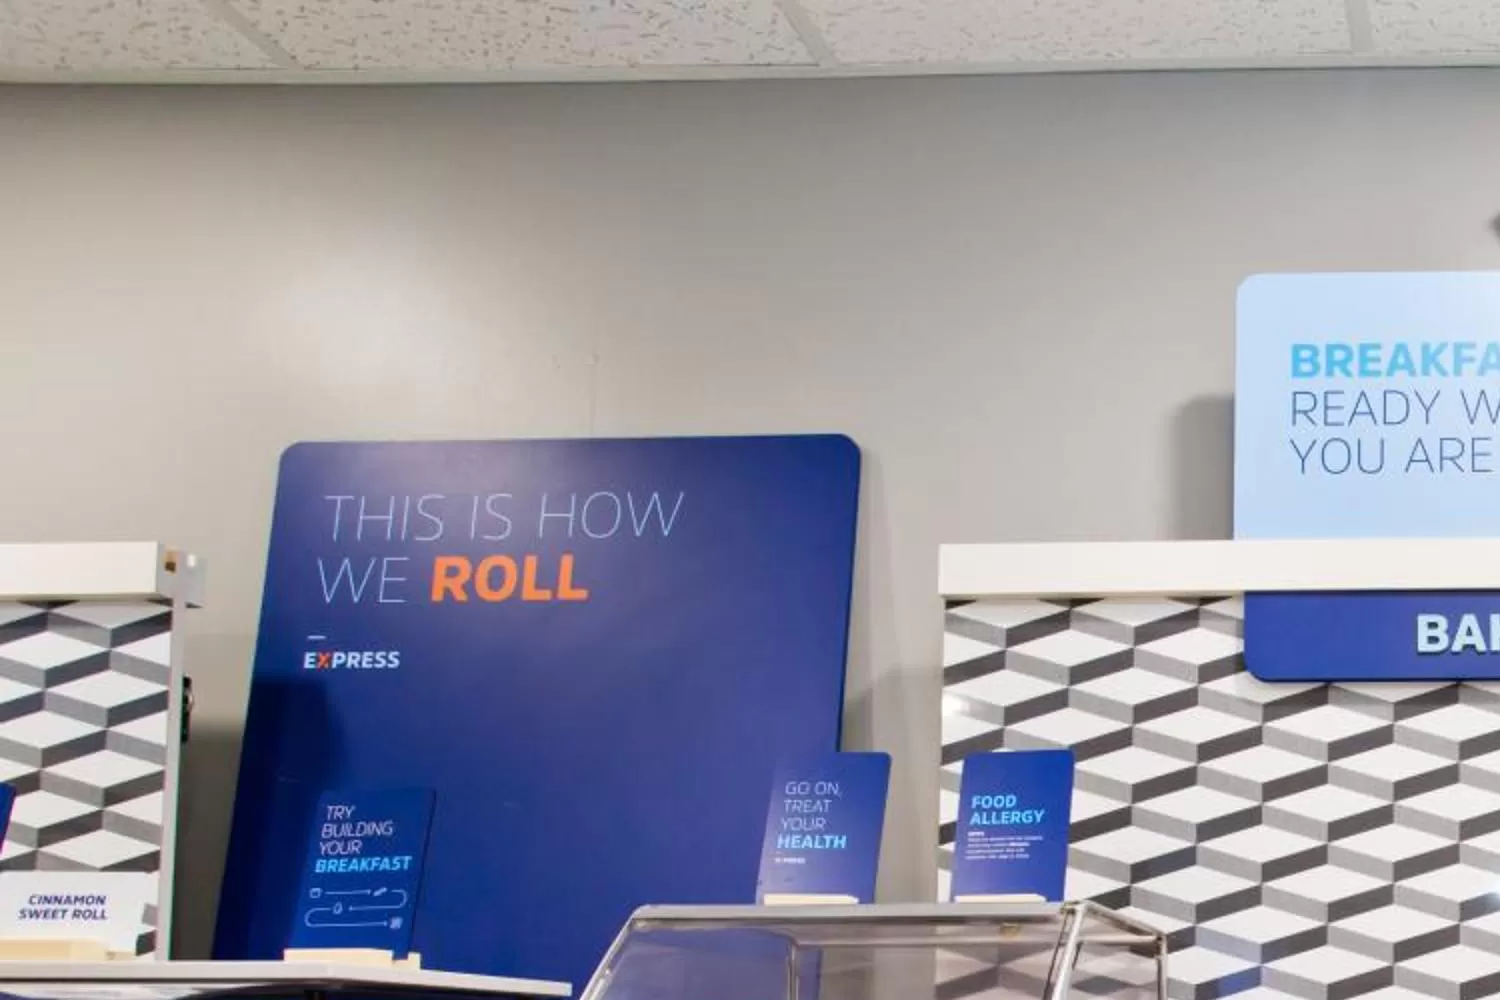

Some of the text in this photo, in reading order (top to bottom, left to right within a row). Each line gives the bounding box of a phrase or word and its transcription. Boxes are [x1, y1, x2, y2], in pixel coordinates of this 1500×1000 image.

[1290, 390, 1441, 427] READY
[1289, 436, 1494, 475] YOU ARE
[325, 491, 685, 542] THIS IS HOW
[317, 554, 589, 604] WE ROLL
[304, 651, 401, 670] EXPRESS
[785, 781, 810, 795] GO
[783, 799, 832, 813] TREAT
[971, 795, 1017, 809] FOOD
[327, 805, 356, 820] TRY
[969, 809, 1045, 825] ALLERGY
[321, 820, 394, 839] BUILDING
[781, 817, 826, 831] YOUR
[319, 840, 363, 856] YOUR
[776, 835, 847, 849] HEALTH
[315, 855, 412, 873] BREAKFAST
[29, 894, 107, 905] CINNAMON
[18, 908, 108, 920] SWEET ROLL
